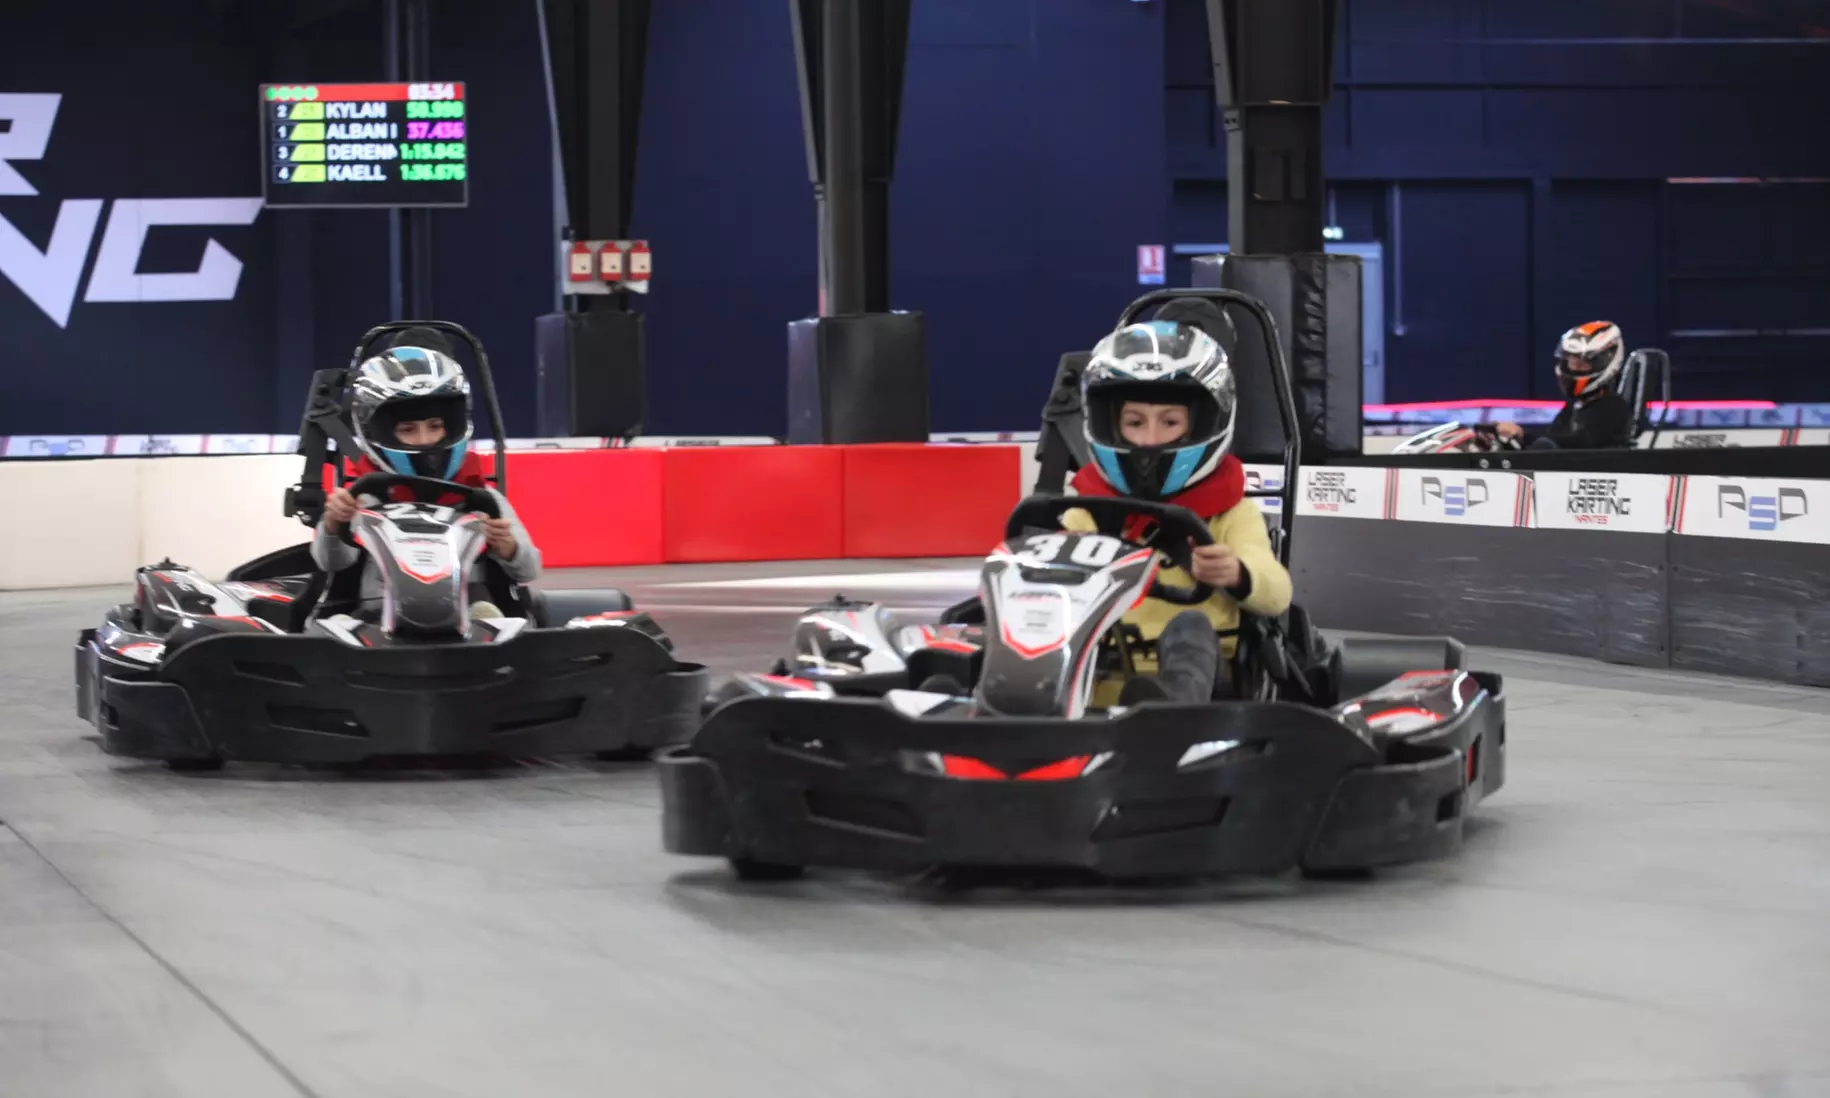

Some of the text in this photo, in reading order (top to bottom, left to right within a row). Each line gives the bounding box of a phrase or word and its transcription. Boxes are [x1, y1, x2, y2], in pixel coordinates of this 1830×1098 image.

[277, 104, 288, 118] 2
[326, 102, 387, 119] KYLAN
[278, 125, 287, 138] 1
[326, 122, 388, 139] ALBAN
[278, 146, 289, 160] 3
[278, 167, 289, 180] 4
[327, 164, 387, 181] KAELL
[1308, 471, 1345, 487] LASER
[1569, 479, 1617, 496] LASER
[1307, 487, 1357, 504] KARTING
[1567, 496, 1631, 515] KARTING
[1025, 534, 1122, 567] 30
